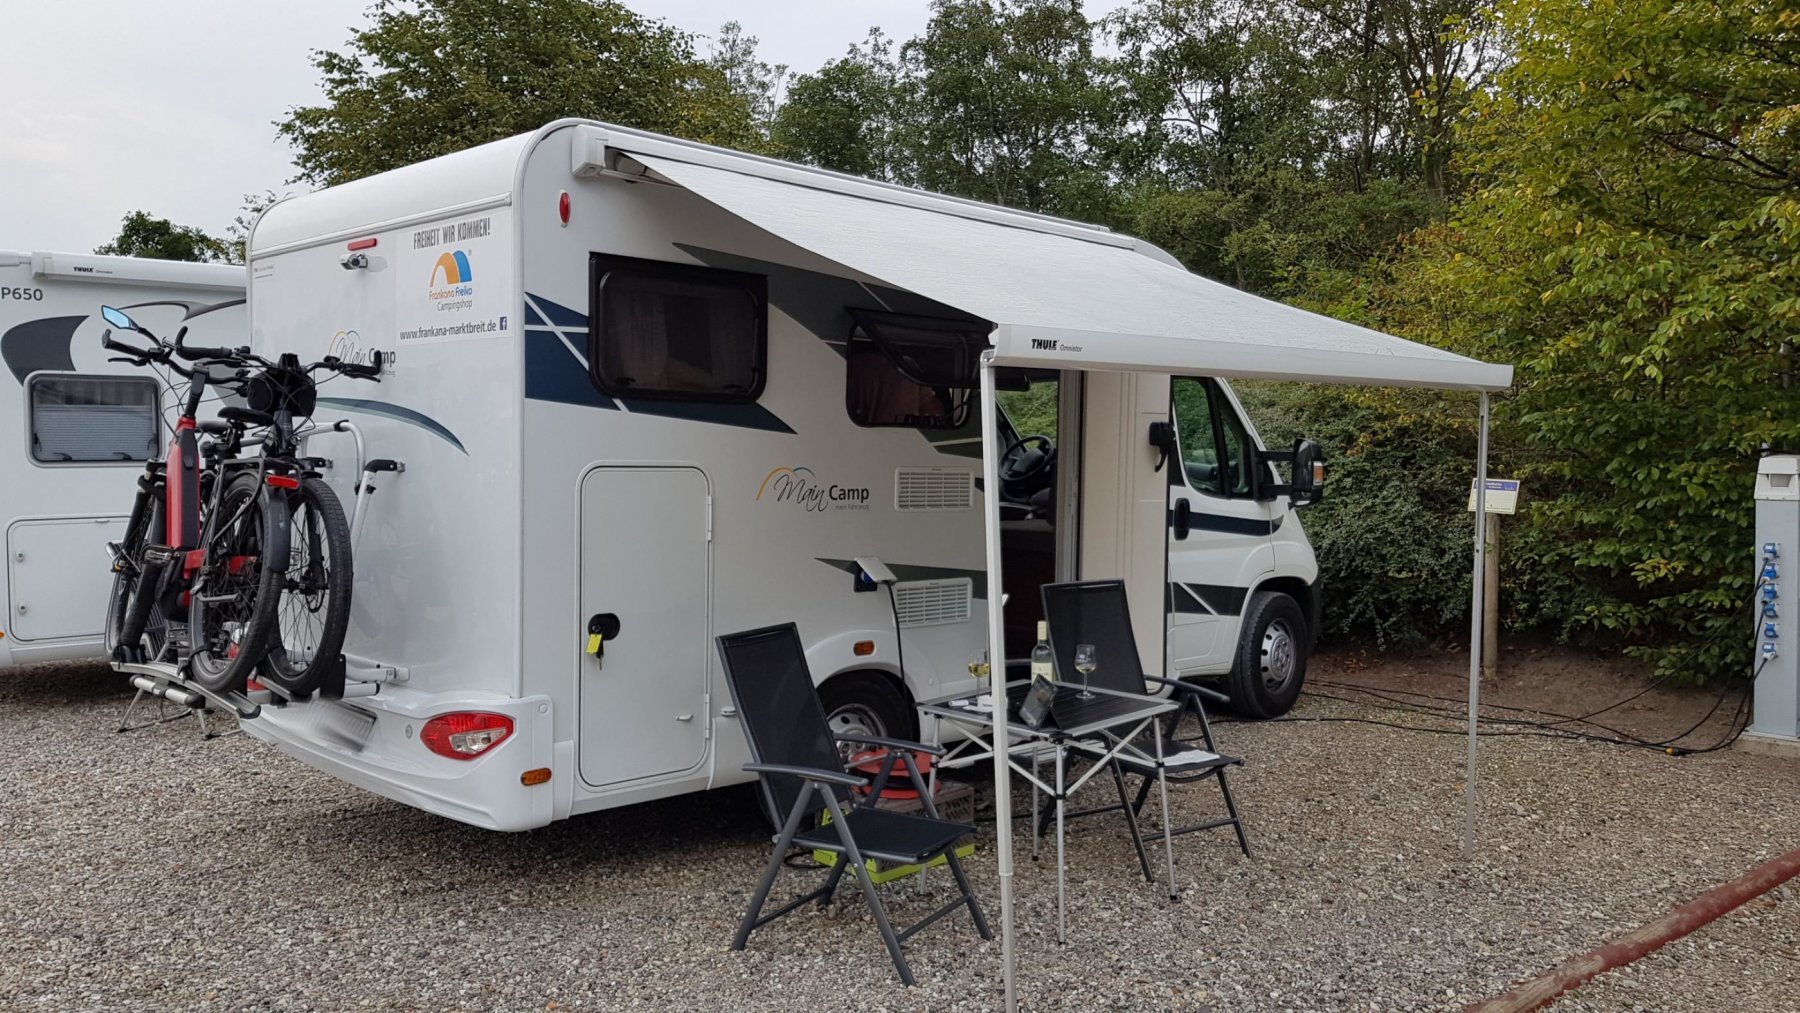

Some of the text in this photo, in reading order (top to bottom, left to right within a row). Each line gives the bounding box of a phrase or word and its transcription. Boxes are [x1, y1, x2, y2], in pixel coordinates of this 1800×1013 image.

[413, 217, 491, 250] FREIHEIT WIR KOMMEN!
[1, 287, 43, 301] P650
[429, 286, 472, 300] Frankana Freiko
[437, 299, 472, 312] Campingshop
[399, 320, 497, 340] www.frankana-marktbreit.de
[1031, 338, 1083, 352] THULE Omnistor
[369, 347, 396, 368] Cmp
[774, 474, 870, 512] Main Camp
